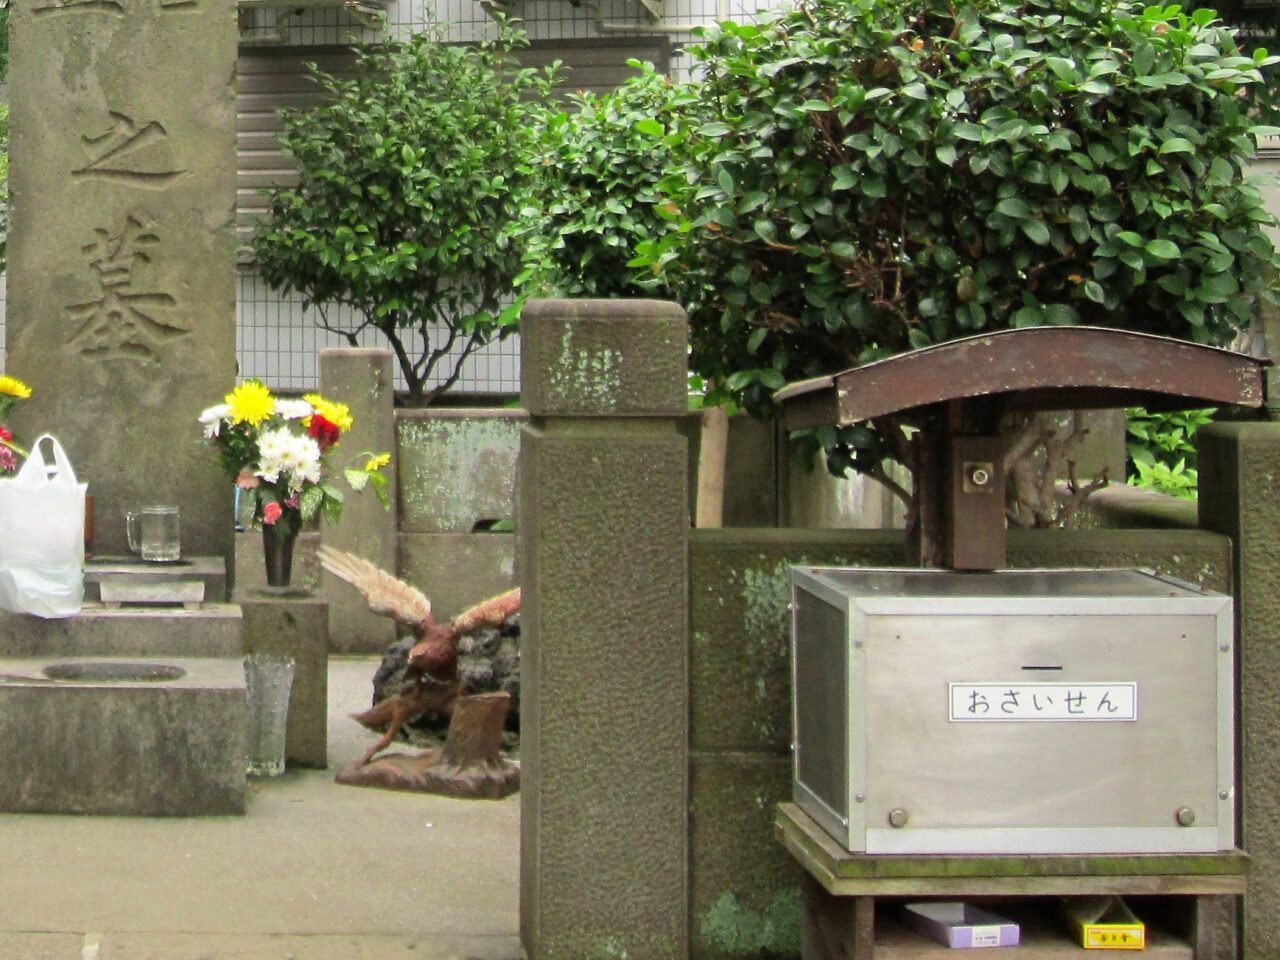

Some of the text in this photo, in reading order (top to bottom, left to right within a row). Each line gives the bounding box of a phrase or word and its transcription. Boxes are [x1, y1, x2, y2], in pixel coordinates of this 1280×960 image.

[968, 689, 1118, 714] おさいせん
